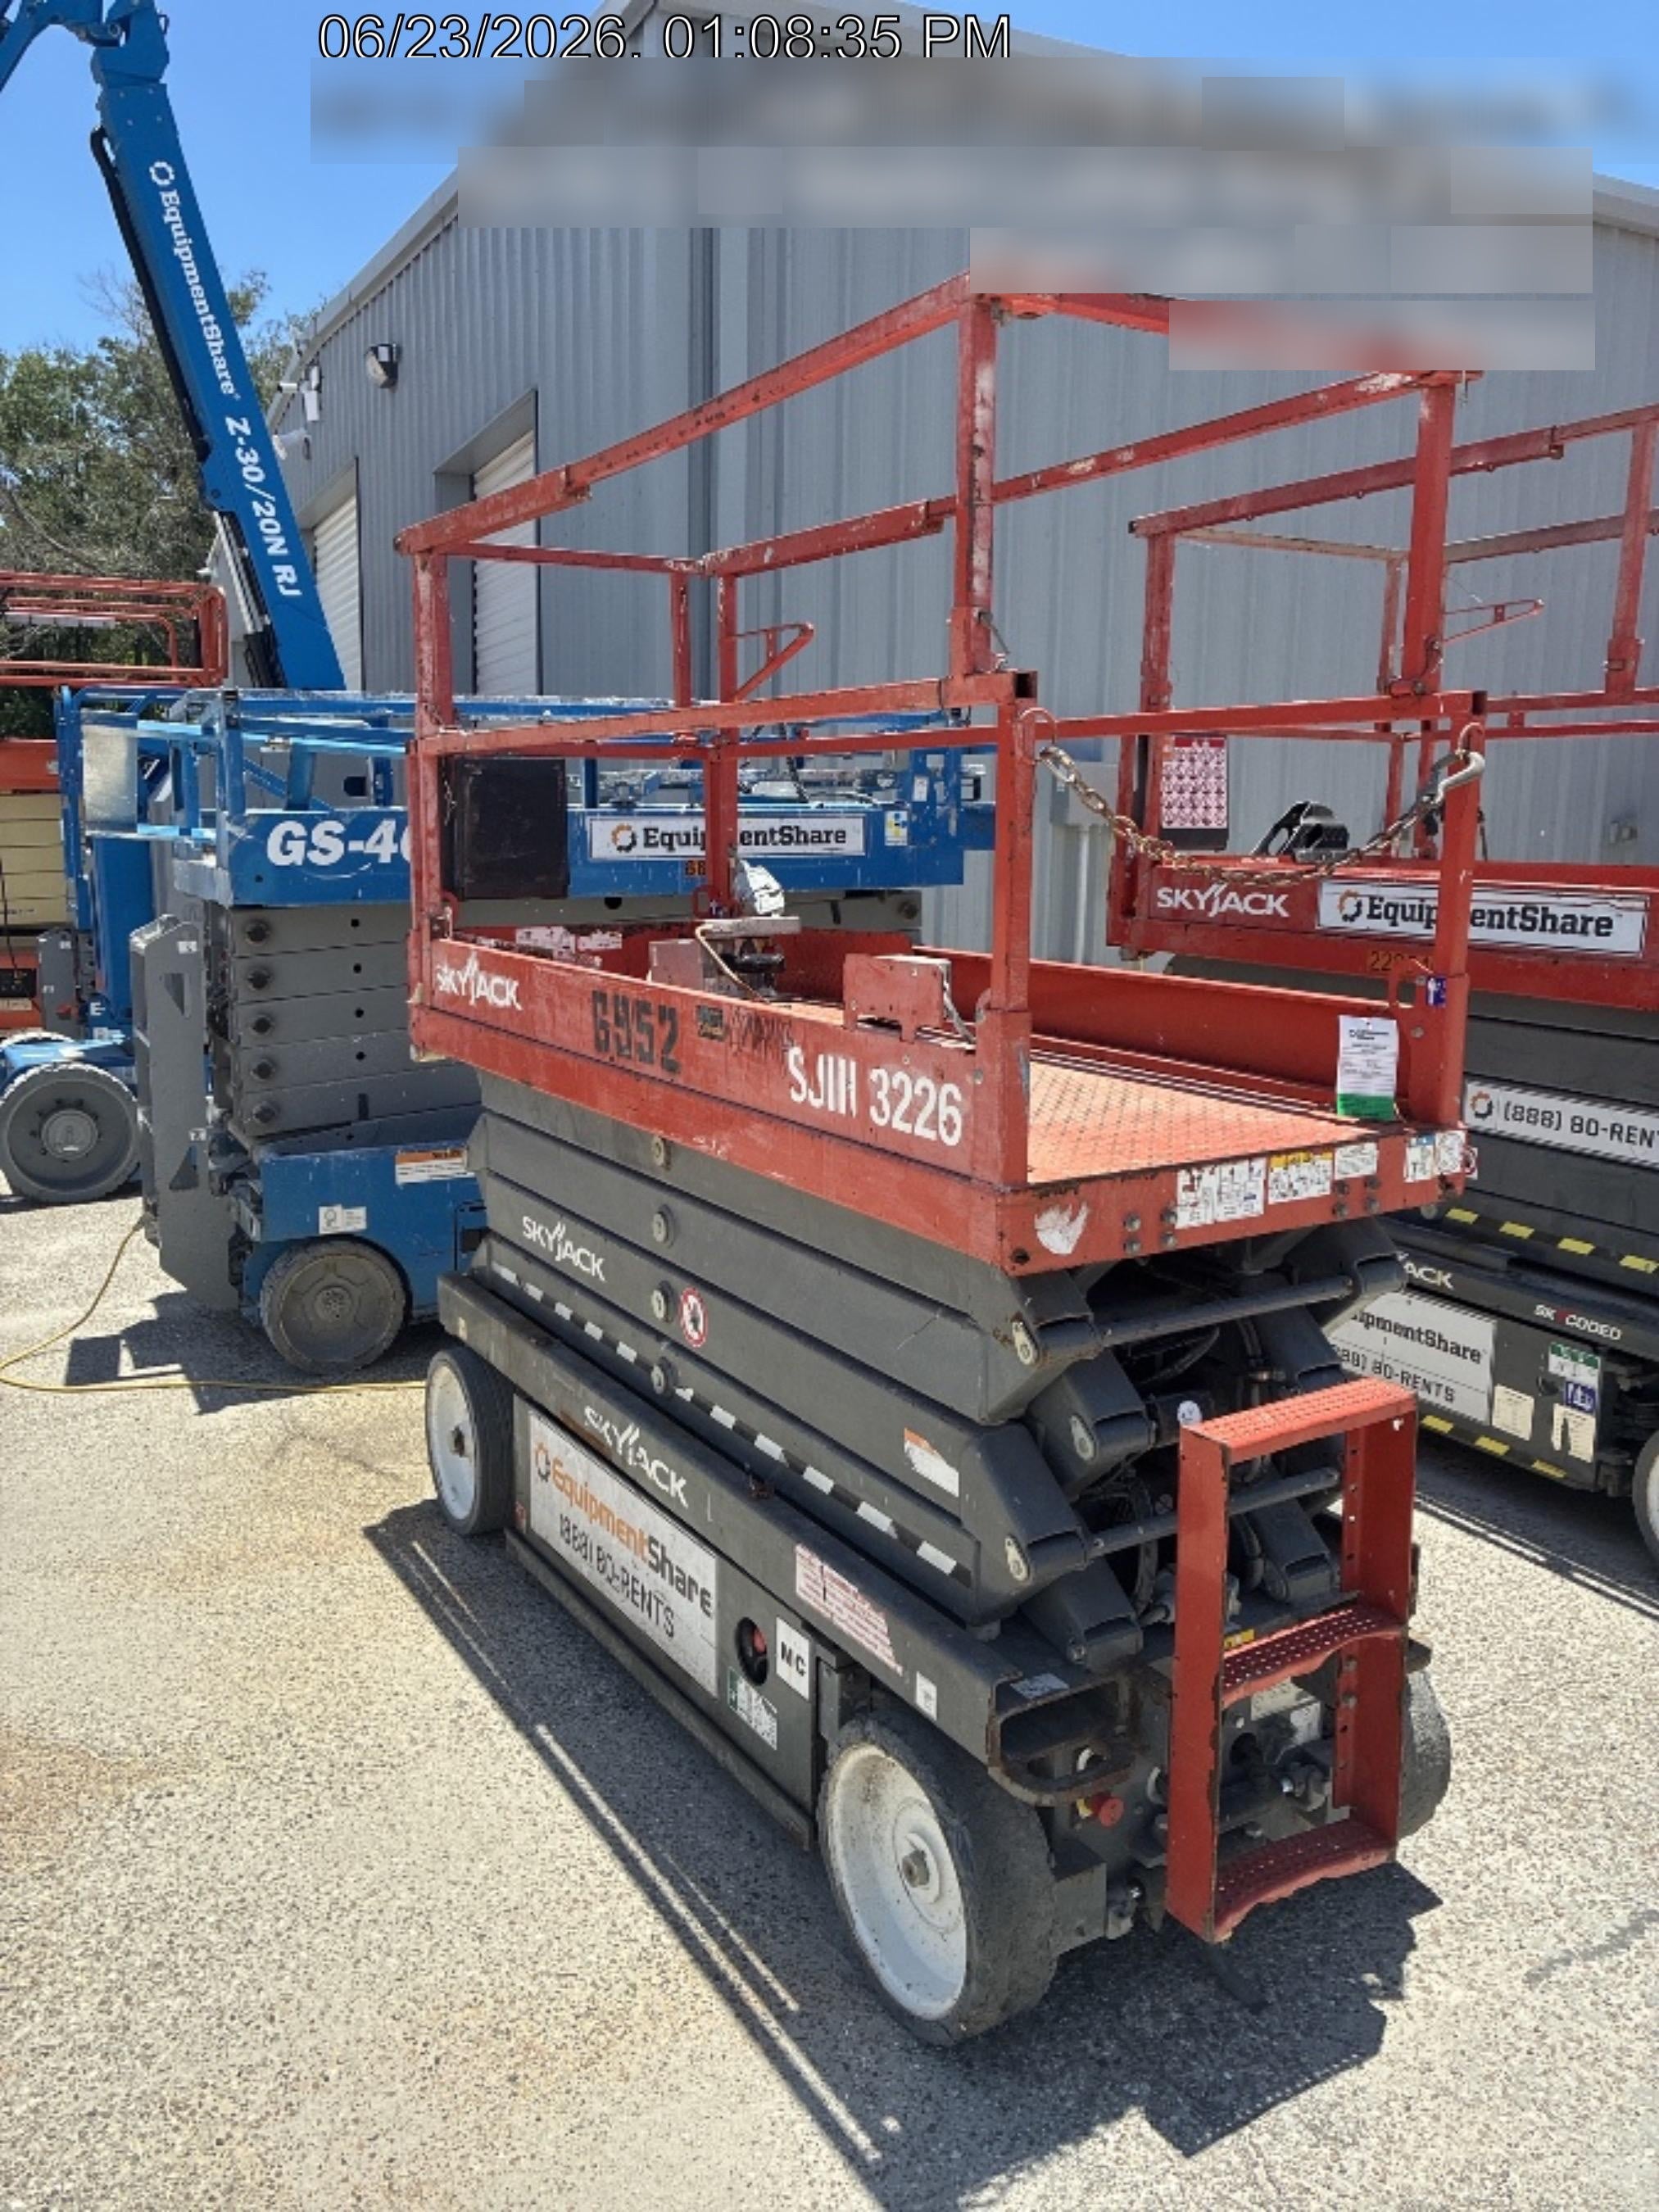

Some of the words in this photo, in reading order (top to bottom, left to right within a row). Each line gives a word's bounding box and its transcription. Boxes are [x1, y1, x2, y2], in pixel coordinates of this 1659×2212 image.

[159, 189, 236, 396] EquipmentShare
[225, 416, 289, 555] Z-30/20N
[270, 564, 302, 596] RJ
[267, 818, 411, 867] GS-4
[643, 826, 846, 853] EquientShare
[1157, 882, 1290, 918] SKYJACK
[1367, 895, 1614, 937] EquipentShare
[436, 950, 523, 1011] SKYJACK
[592, 990, 682, 1073] 6952
[869, 1067, 962, 1146] 3226
[1503, 1101, 1562, 1131] (888)
[1571, 1115, 1659, 1149] 80-REN
[523, 1216, 605, 1283] SKYJACK
[1371, 1358, 1456, 1403] 80-RENTS
[584, 1405, 689, 1508] SKYJACK
[551, 1457, 715, 1620] EquipmentShare
